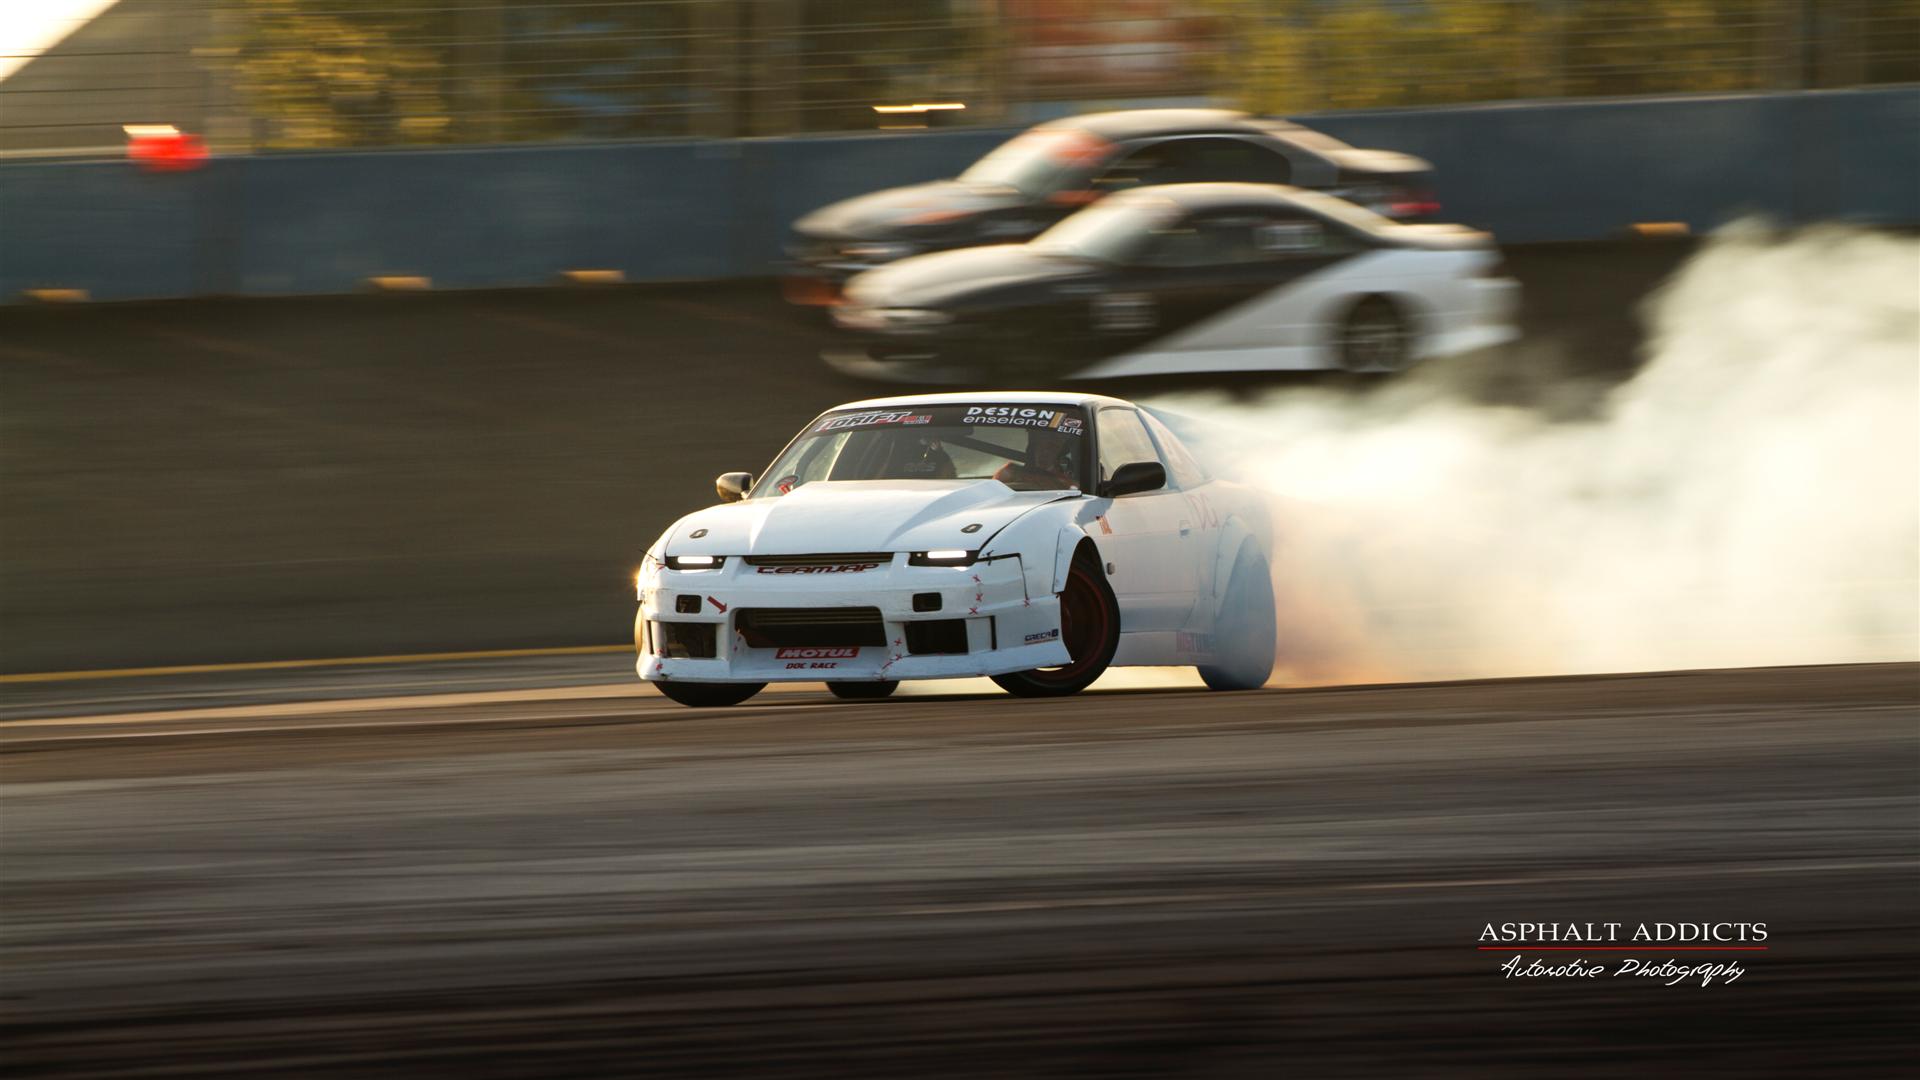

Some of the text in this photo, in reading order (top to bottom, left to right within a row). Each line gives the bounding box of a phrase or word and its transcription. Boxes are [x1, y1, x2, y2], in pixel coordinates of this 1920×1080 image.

[967, 407, 1055, 420] DESIGN
[1057, 426, 1083, 436] ELITE
[780, 648, 854, 658] MOTUL
